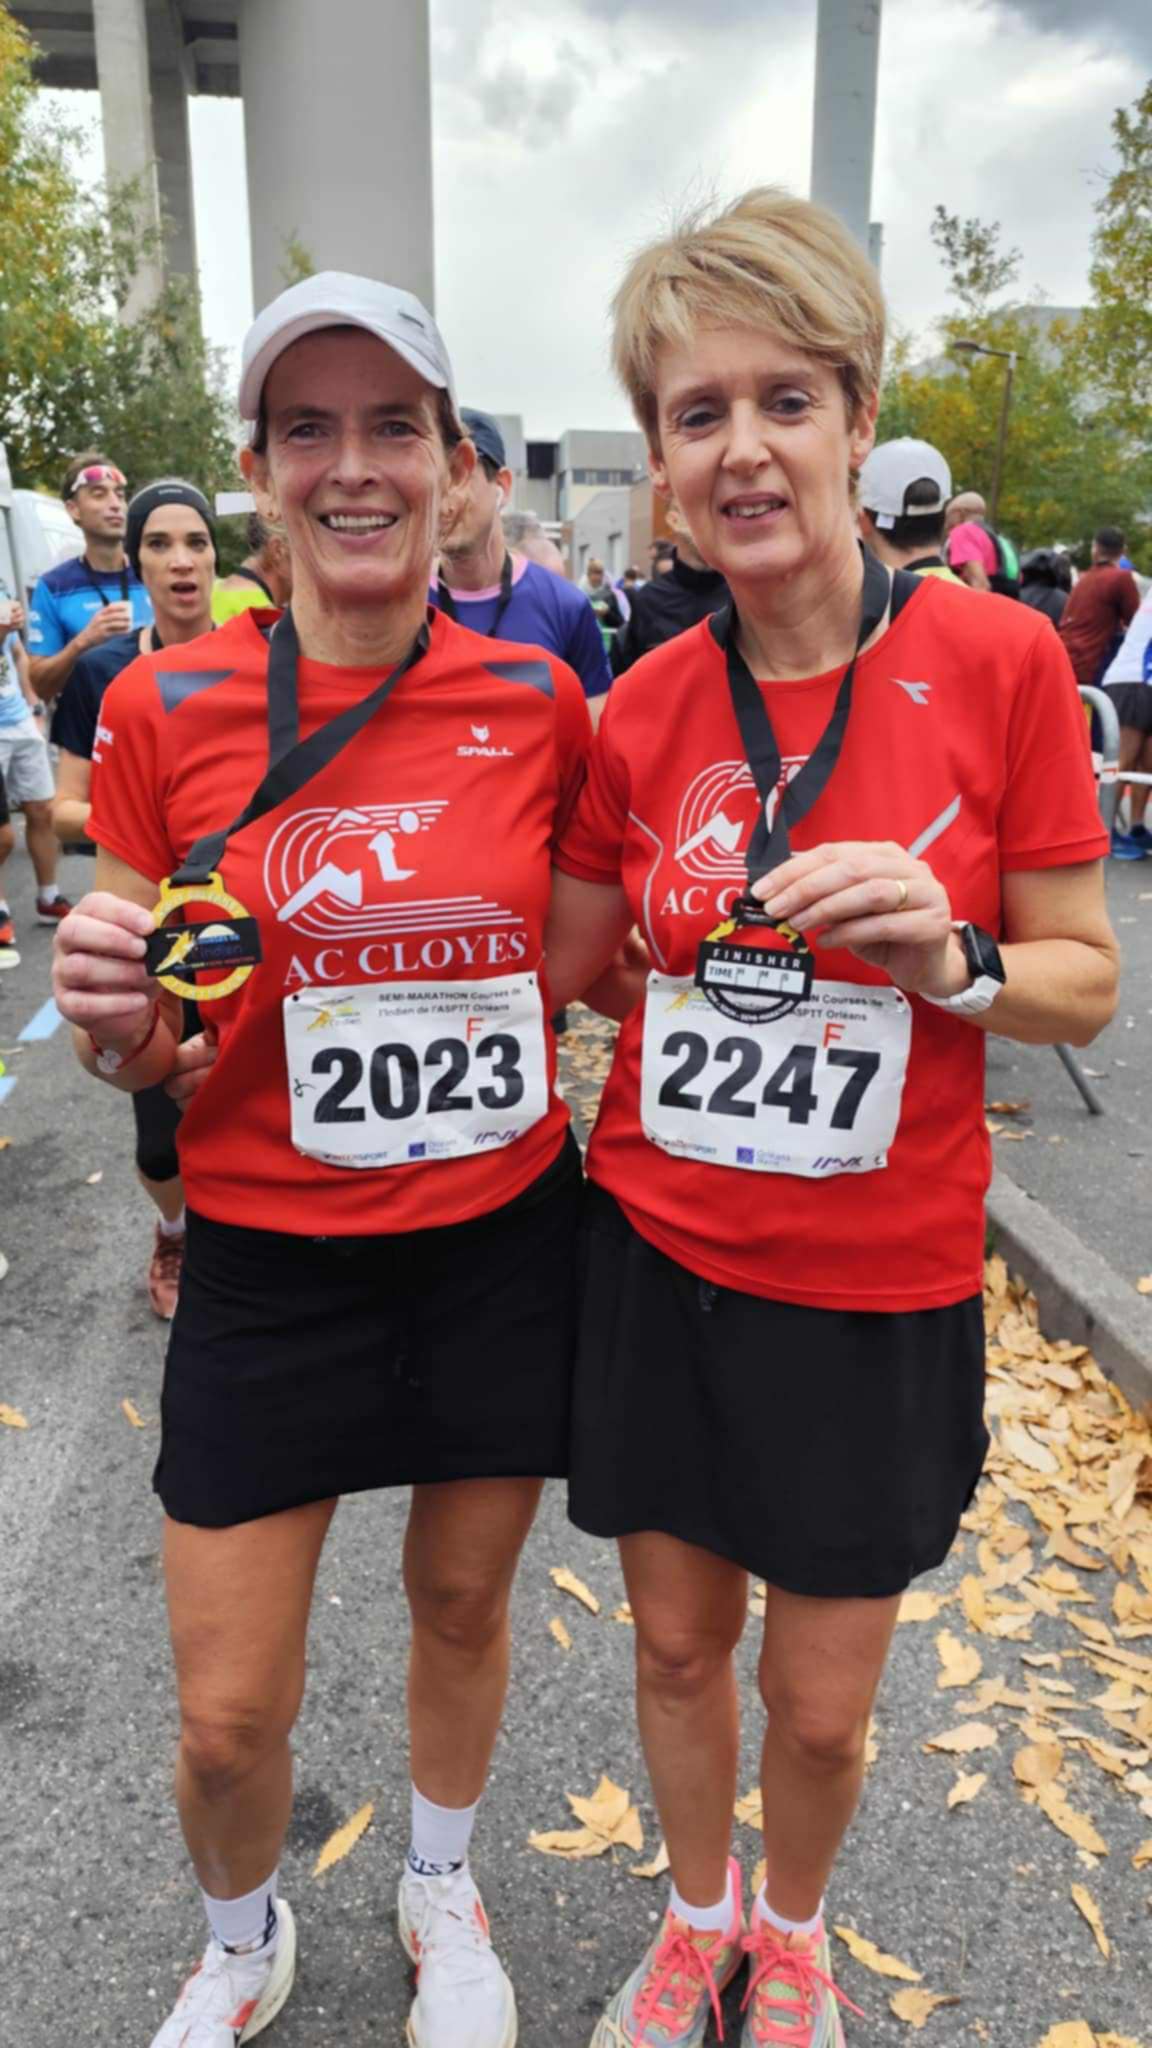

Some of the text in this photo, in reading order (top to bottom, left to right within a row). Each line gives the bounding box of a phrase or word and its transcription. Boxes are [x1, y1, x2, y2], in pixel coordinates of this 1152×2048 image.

[456, 746, 515, 757] SPALL
[660, 886, 707, 916] AC
[283, 949, 345, 986] AC
[358, 931, 527, 976] CLOYES
[713, 948, 801, 969] FINISHER
[709, 966, 733, 978] TIME
[379, 991, 468, 1002] SEMI-MARATHON
[470, 990, 508, 1000] Courses
[823, 994, 867, 1005] Courses
[826, 1009, 867, 1020] Orléans
[467, 1017, 484, 1041] F
[823, 1023, 845, 1048] F
[311, 1033, 524, 1123] 2023
[658, 1031, 881, 1130] 2247
